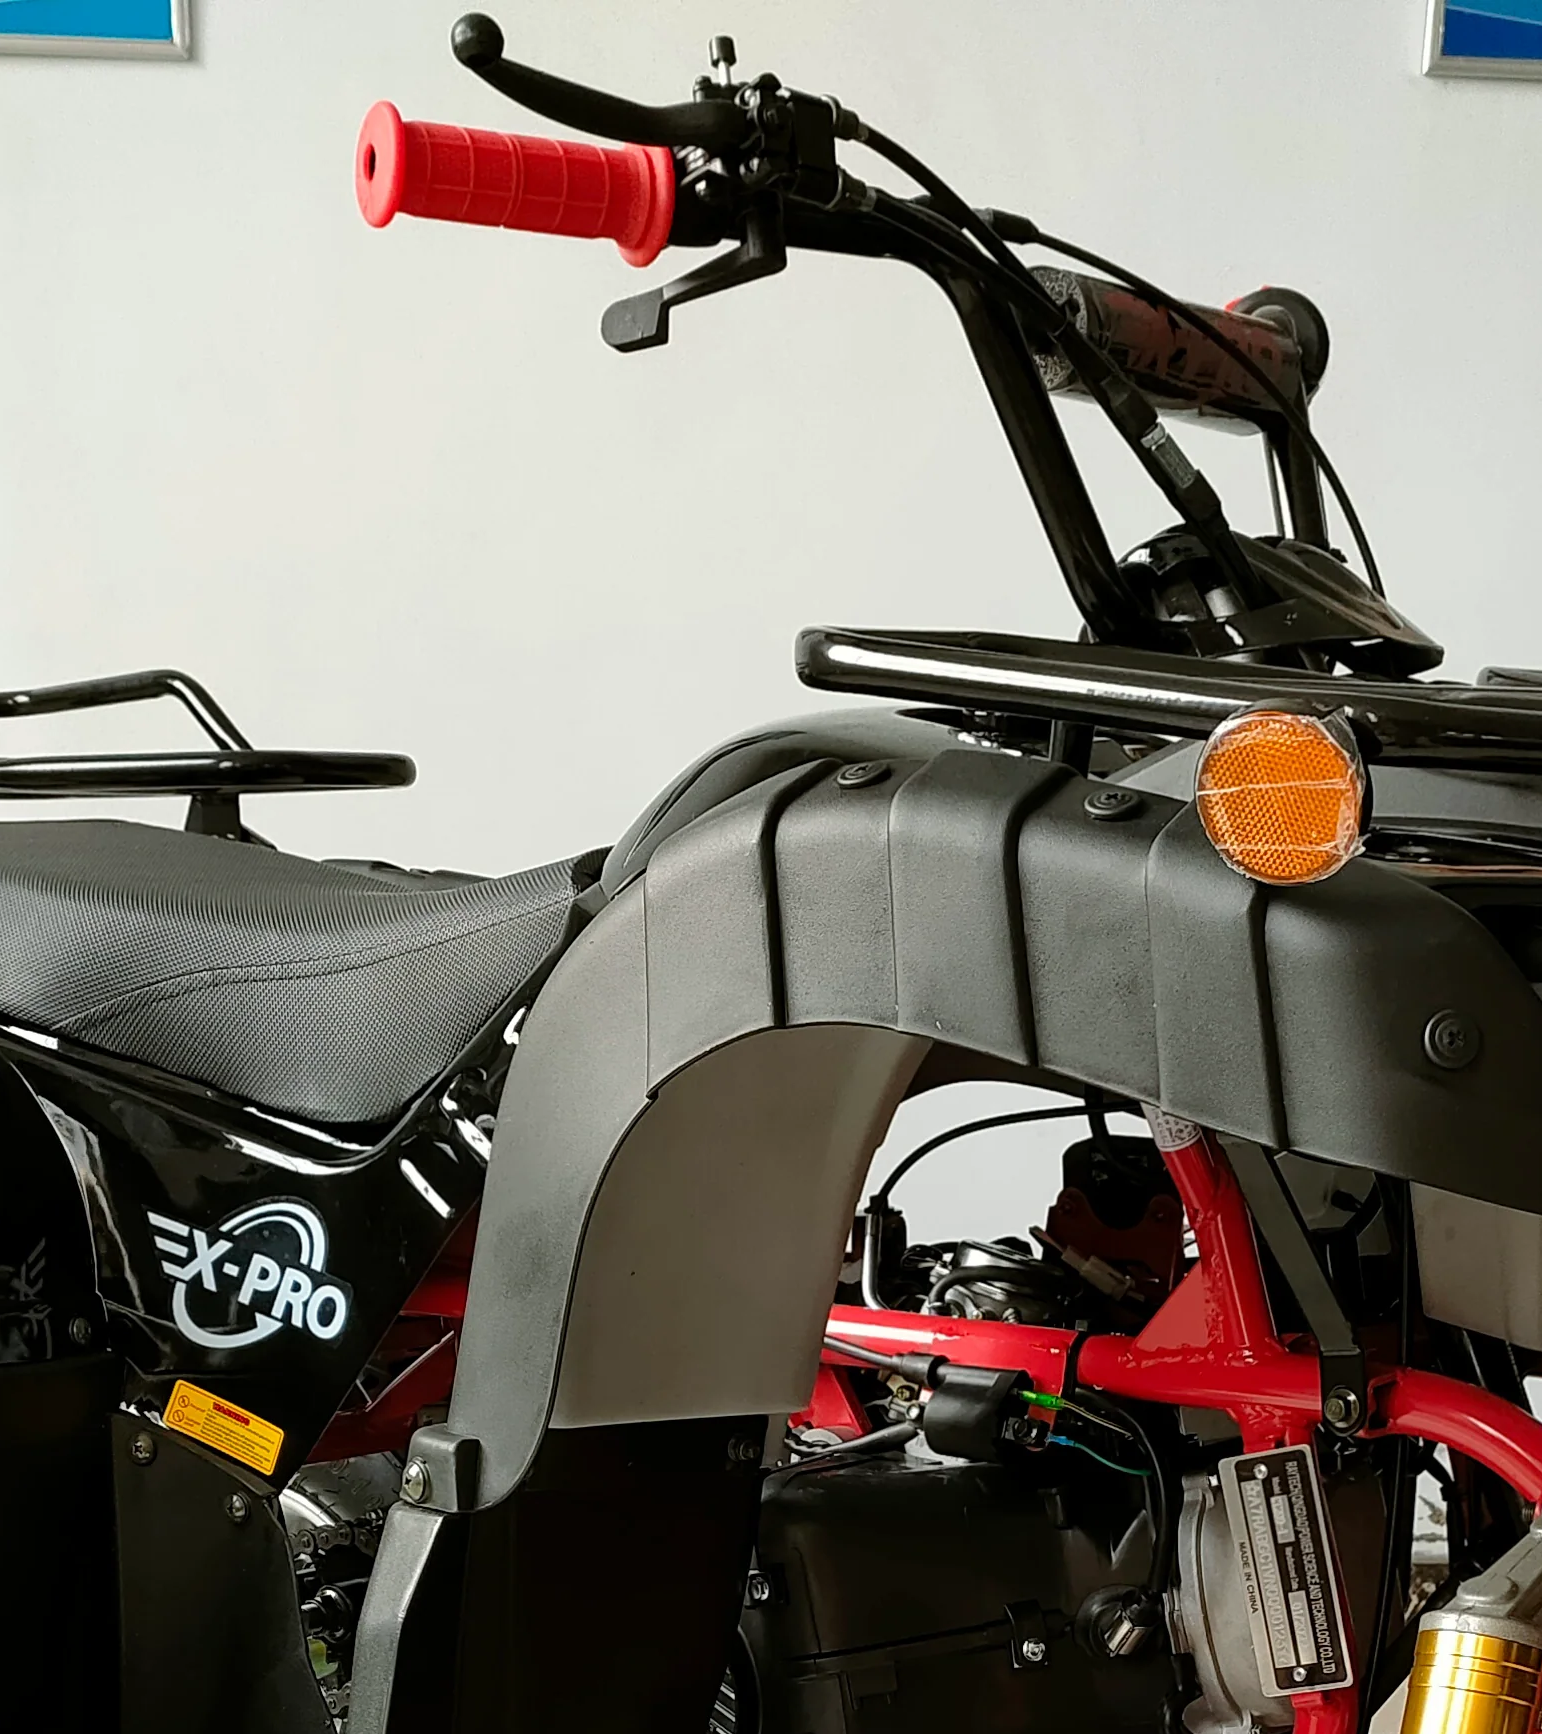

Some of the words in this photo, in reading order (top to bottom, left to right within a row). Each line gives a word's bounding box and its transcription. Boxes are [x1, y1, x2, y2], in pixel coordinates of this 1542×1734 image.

[1239, 1541, 1250, 1569] MADE
[1244, 1572, 1253, 1581] IN
[1247, 1584, 1259, 1613] CHINA
[1308, 1584, 1321, 1600] AND
[1311, 1599, 1330, 1647] TECHNOLOGY
